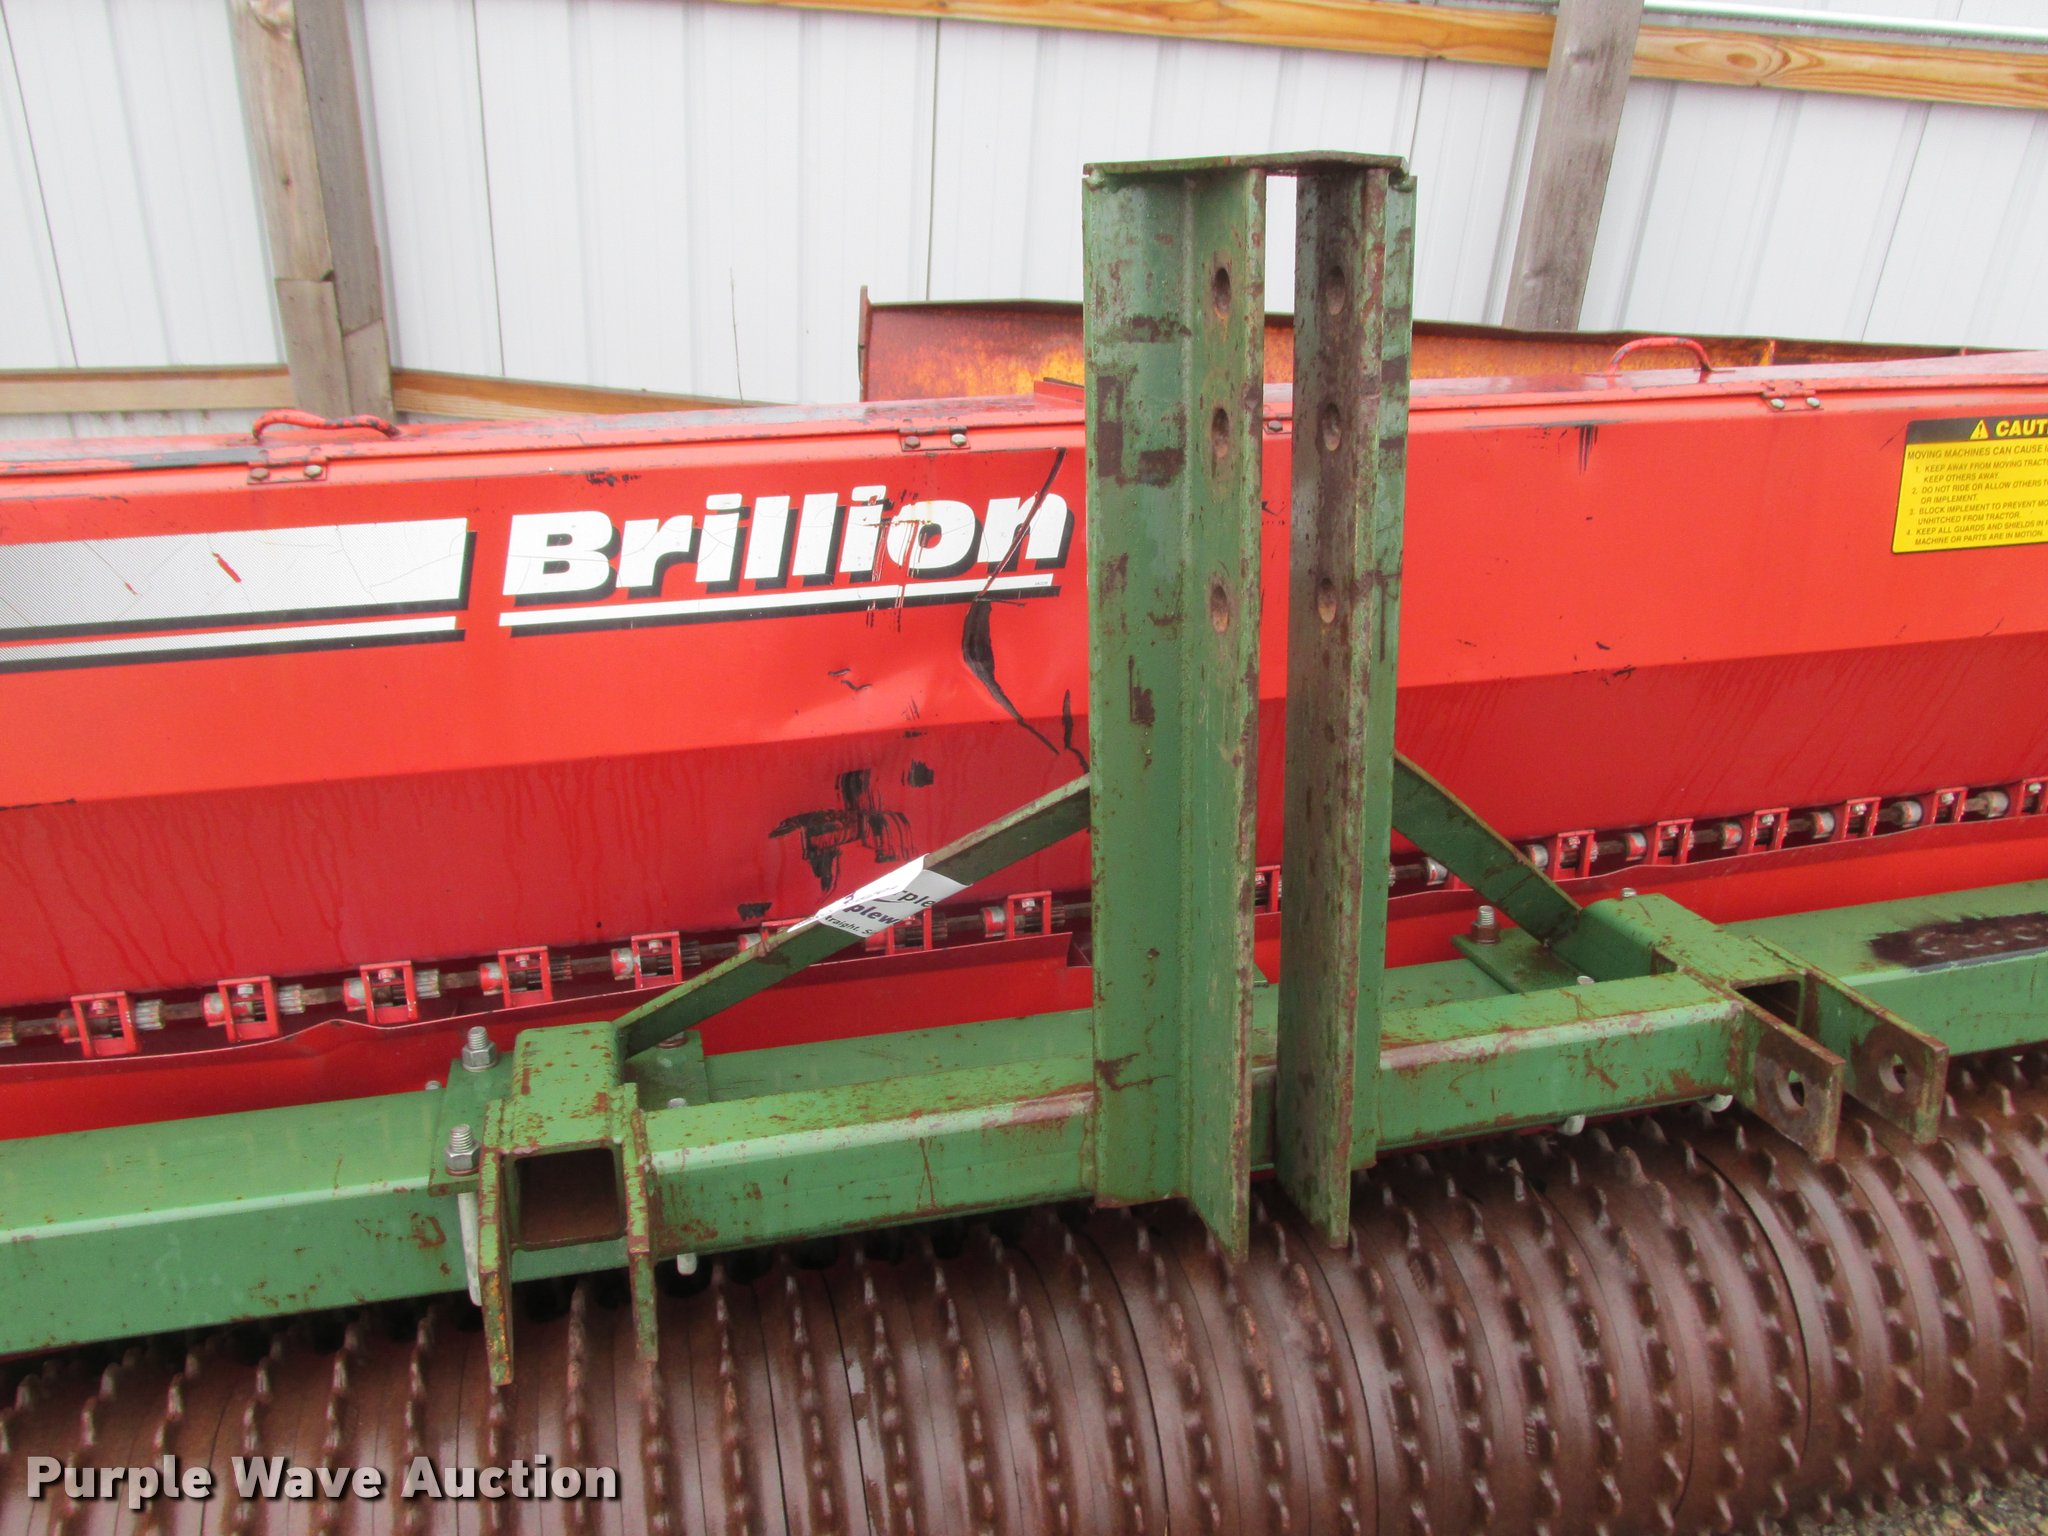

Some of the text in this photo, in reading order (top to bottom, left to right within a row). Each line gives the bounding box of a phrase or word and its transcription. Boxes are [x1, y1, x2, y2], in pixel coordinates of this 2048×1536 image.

[1995, 417, 2048, 437] CAUT
[1907, 450, 1942, 460] MOVING
[1944, 448, 1991, 458] MACHINES
[1992, 446, 2012, 456] CAN
[2013, 444, 2044, 454] CAUSE
[1924, 464, 1945, 472] KEEP
[1947, 463, 1968, 471] AWAY
[1970, 461, 1991, 470] FROM
[1993, 460, 2022, 469] MOVING
[1924, 475, 1944, 483] KEEP
[1946, 473, 1976, 482] OTHERS
[1922, 486, 1933, 494] DO
[1935, 485, 1950, 493] NOT
[1952, 483, 1970, 492] RIDE
[1971, 482, 1983, 491] OR
[1985, 481, 2011, 490] ALLOW
[2012, 479, 2042, 488] OTHERS
[1919, 506, 1945, 515] BLOCK
[1947, 503, 1990, 513] IMPLEMENT
[1991, 502, 2001, 510] TO
[2002, 500, 2037, 509] PREVENT
[1920, 496, 1932, 505] OR
[1916, 527, 1936, 535] KEEP
[1938, 526, 1951, 534] ALL
[1954, 524, 1985, 533] GUARDS
[1987, 522, 2002, 531] AND
[2004, 520, 2035, 529] SHIELDS
[2036, 519, 2044, 527] IN
[1918, 516, 1961, 525] UNHITCHED
[1963, 514, 1984, 522] FROM
[502, 484, 1072, 602] Brillion
[1915, 536, 1949, 546] MACHINE
[1951, 535, 1961, 543] OR
[1963, 534, 1987, 542] PARTS
[1989, 532, 2003, 541] ARE
[2005, 531, 2013, 539] IN
